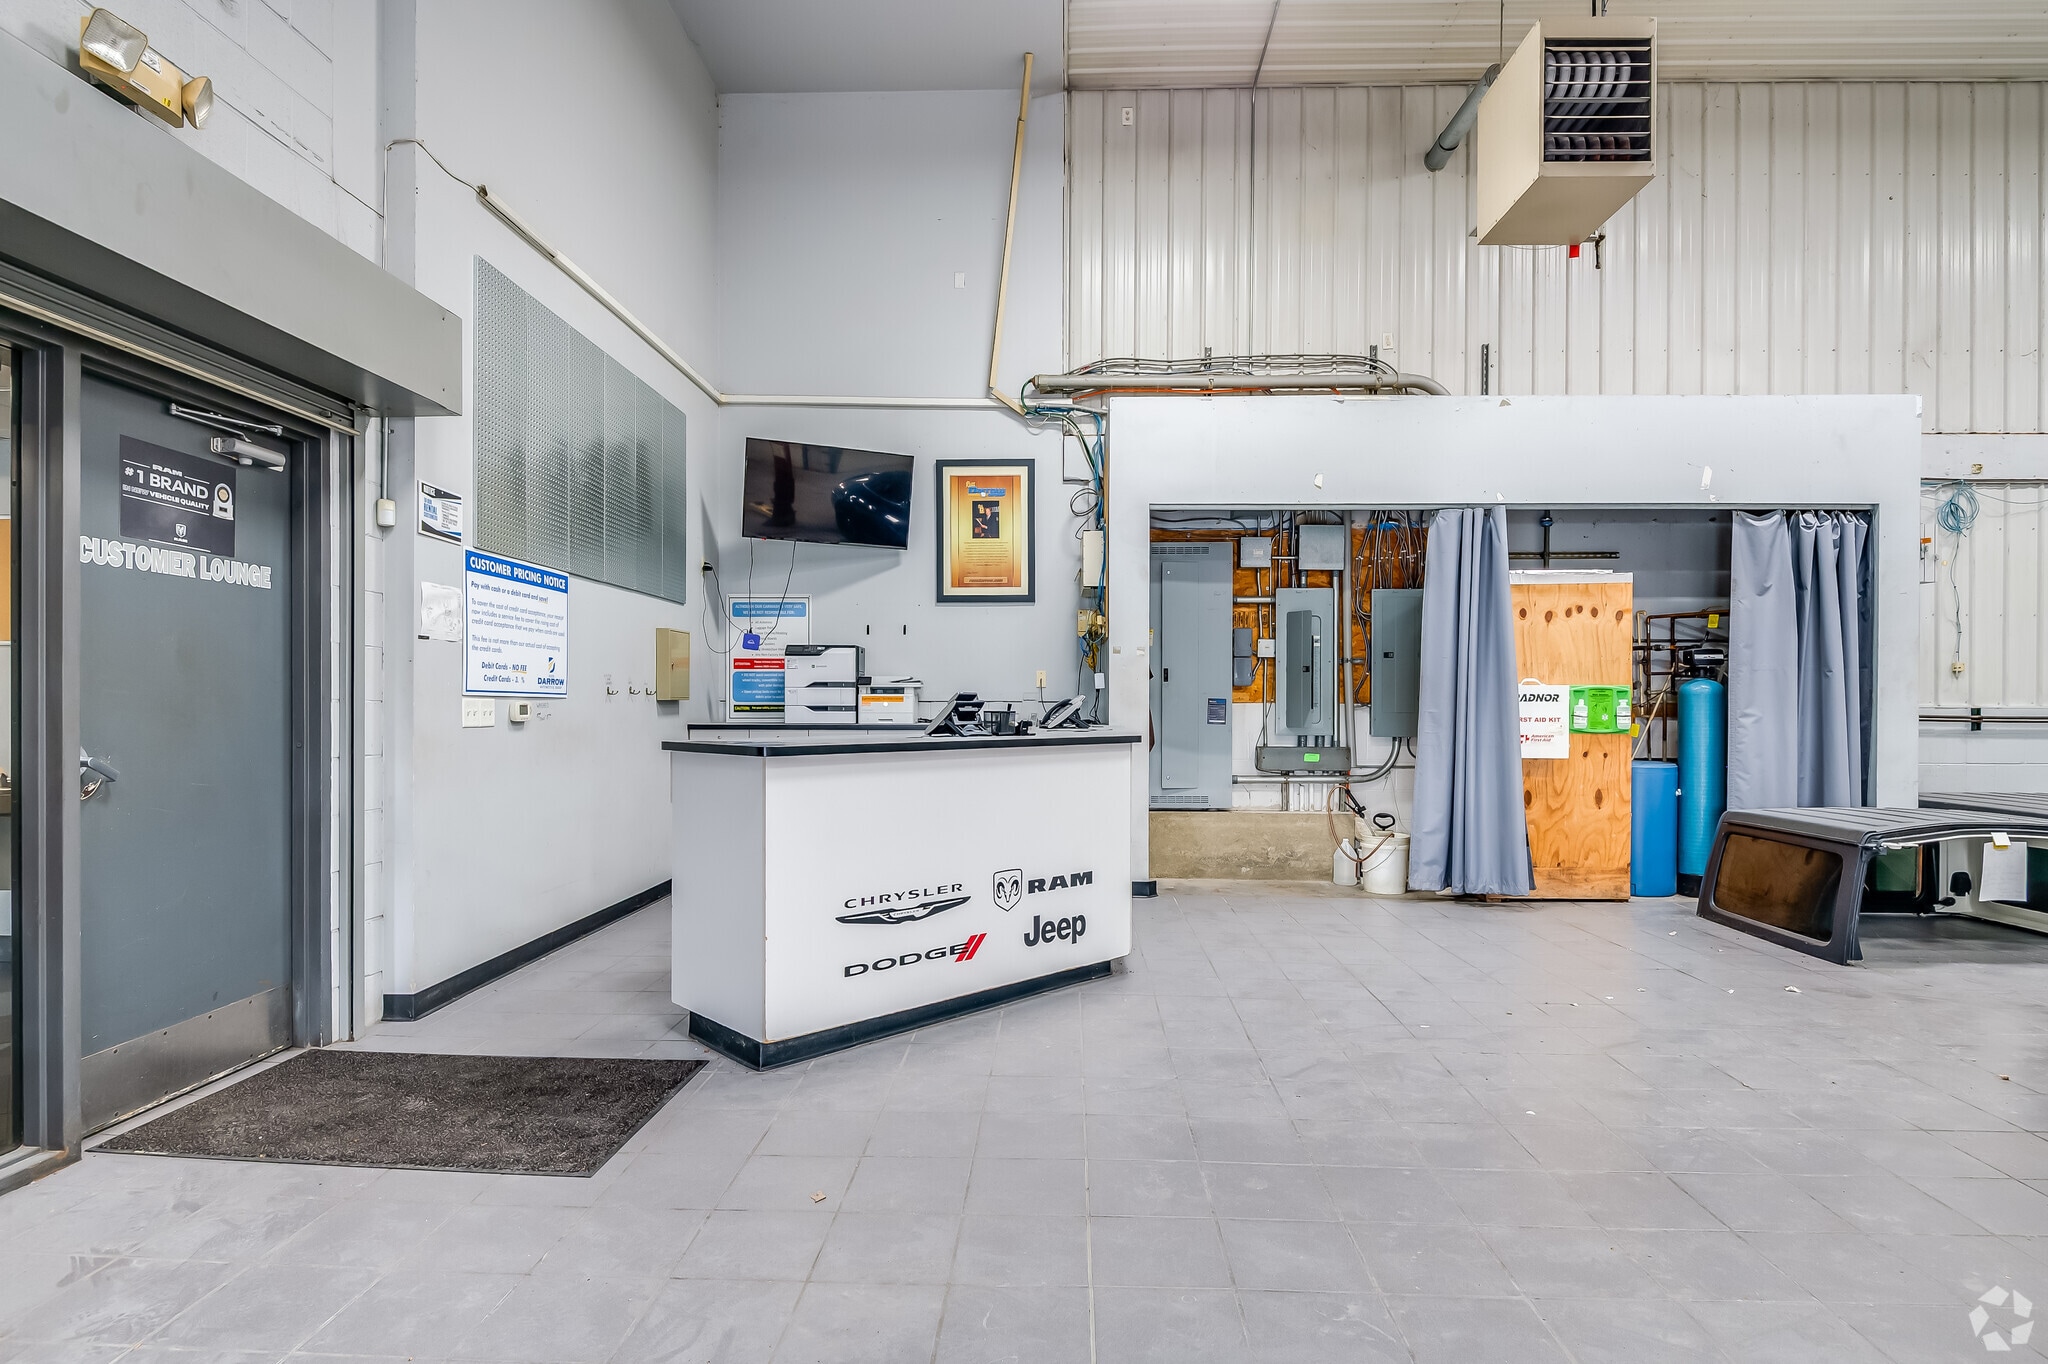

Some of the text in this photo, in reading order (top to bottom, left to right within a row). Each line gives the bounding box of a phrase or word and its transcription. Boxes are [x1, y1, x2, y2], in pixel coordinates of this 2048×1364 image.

[152, 464, 183, 477] RAM
[149, 473, 209, 499] BRAND
[149, 491, 180, 504] VEHICLE
[180, 498, 210, 511] QUALITY
[80, 535, 272, 589] CUSTOMER LOUNGE
[470, 556, 566, 590] CUSTOMER PRICING NOTICE
[471, 580, 480, 590] Pay
[511, 589, 522, 597] debit
[481, 661, 494, 669] Debit
[495, 662, 508, 670] Cards
[512, 663, 519, 671] NO
[483, 674, 498, 682] Credit
[498, 675, 511, 683] Cards
[537, 677, 565, 686] DARROW
[1518, 693, 1560, 702] ADNOR
[1028, 870, 1093, 895] RAM
[844, 883, 963, 909] CHRYSLER
[1024, 914, 1087, 947] Jeep
[844, 943, 970, 978] DODGE
